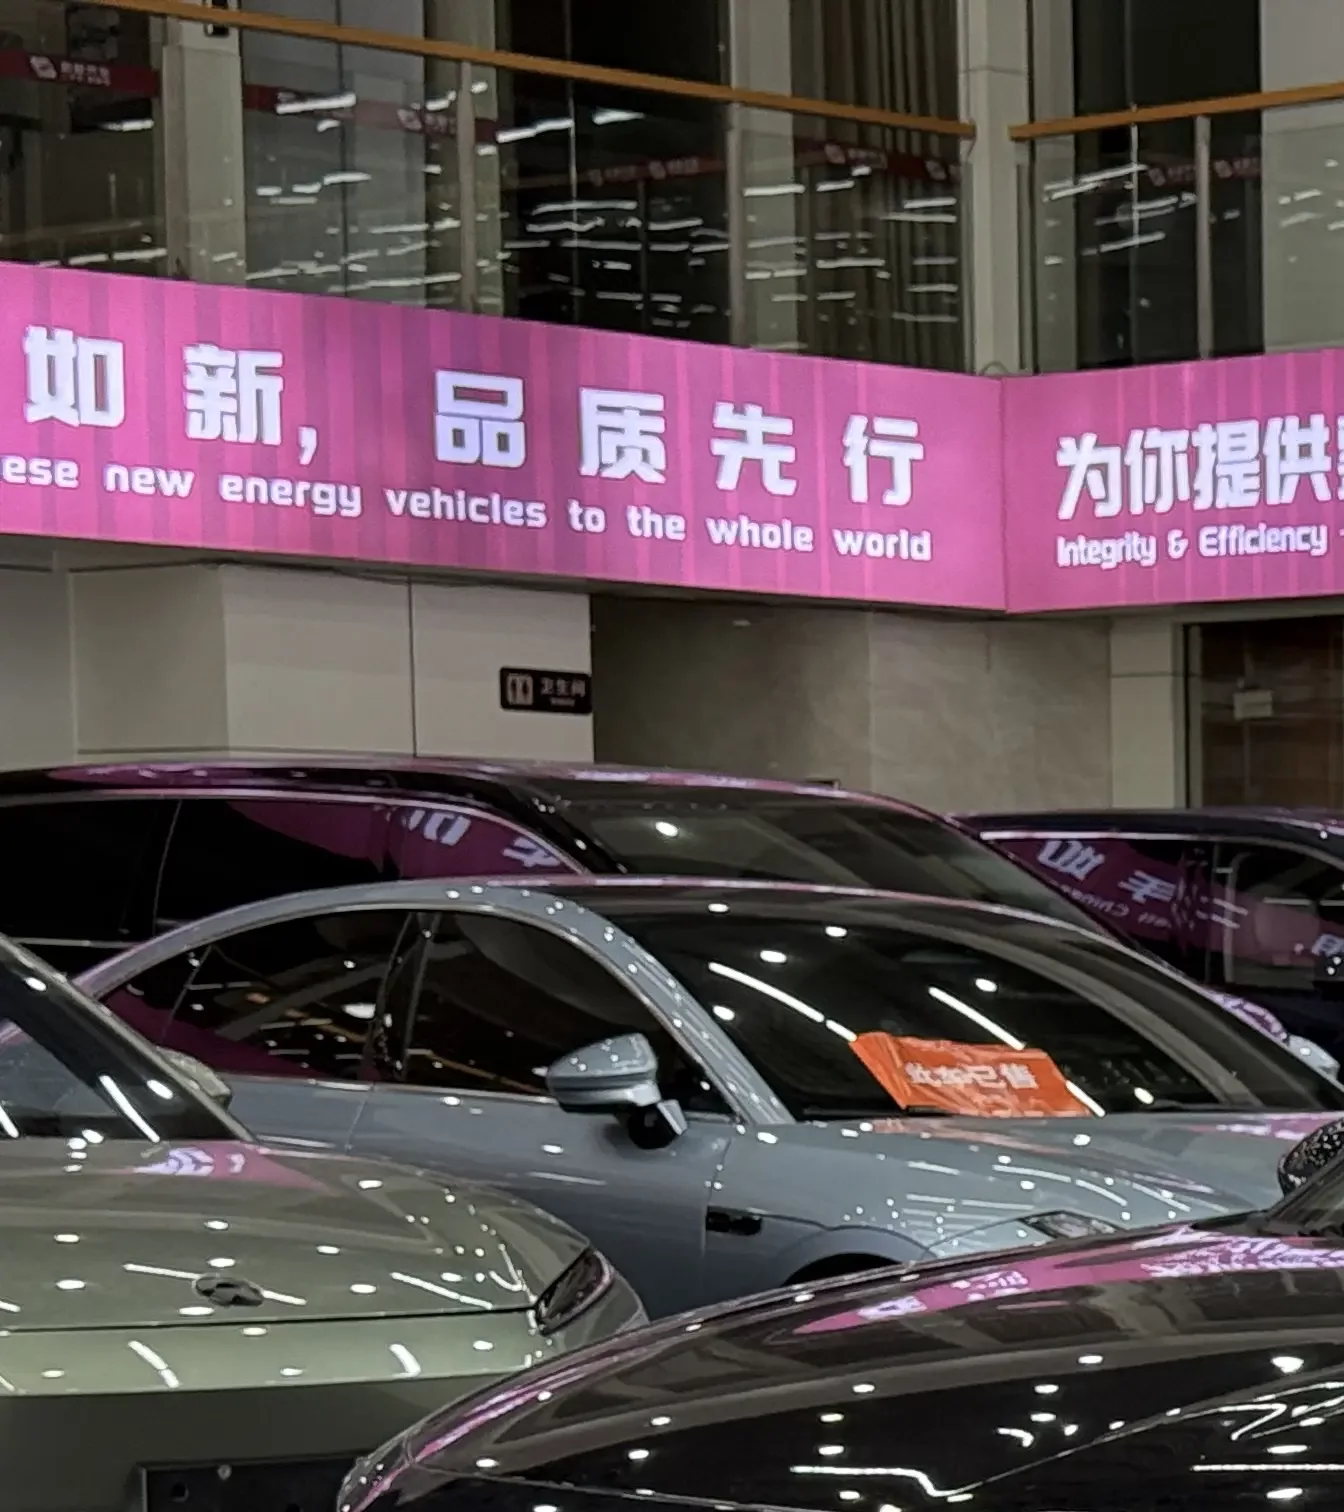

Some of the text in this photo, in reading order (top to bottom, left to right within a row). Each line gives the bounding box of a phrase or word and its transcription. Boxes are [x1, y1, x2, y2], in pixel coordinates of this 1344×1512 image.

[104, 464, 195, 497] new
[219, 473, 363, 517] energy
[386, 487, 547, 528] vehicles
[567, 500, 606, 533] to
[626, 506, 686, 541] the
[706, 516, 814, 552] whole
[833, 528, 932, 561] world
[1056, 532, 1157, 569] Integrity
[1167, 529, 1189, 559] &
[1198, 523, 1329, 556] Efficiency
